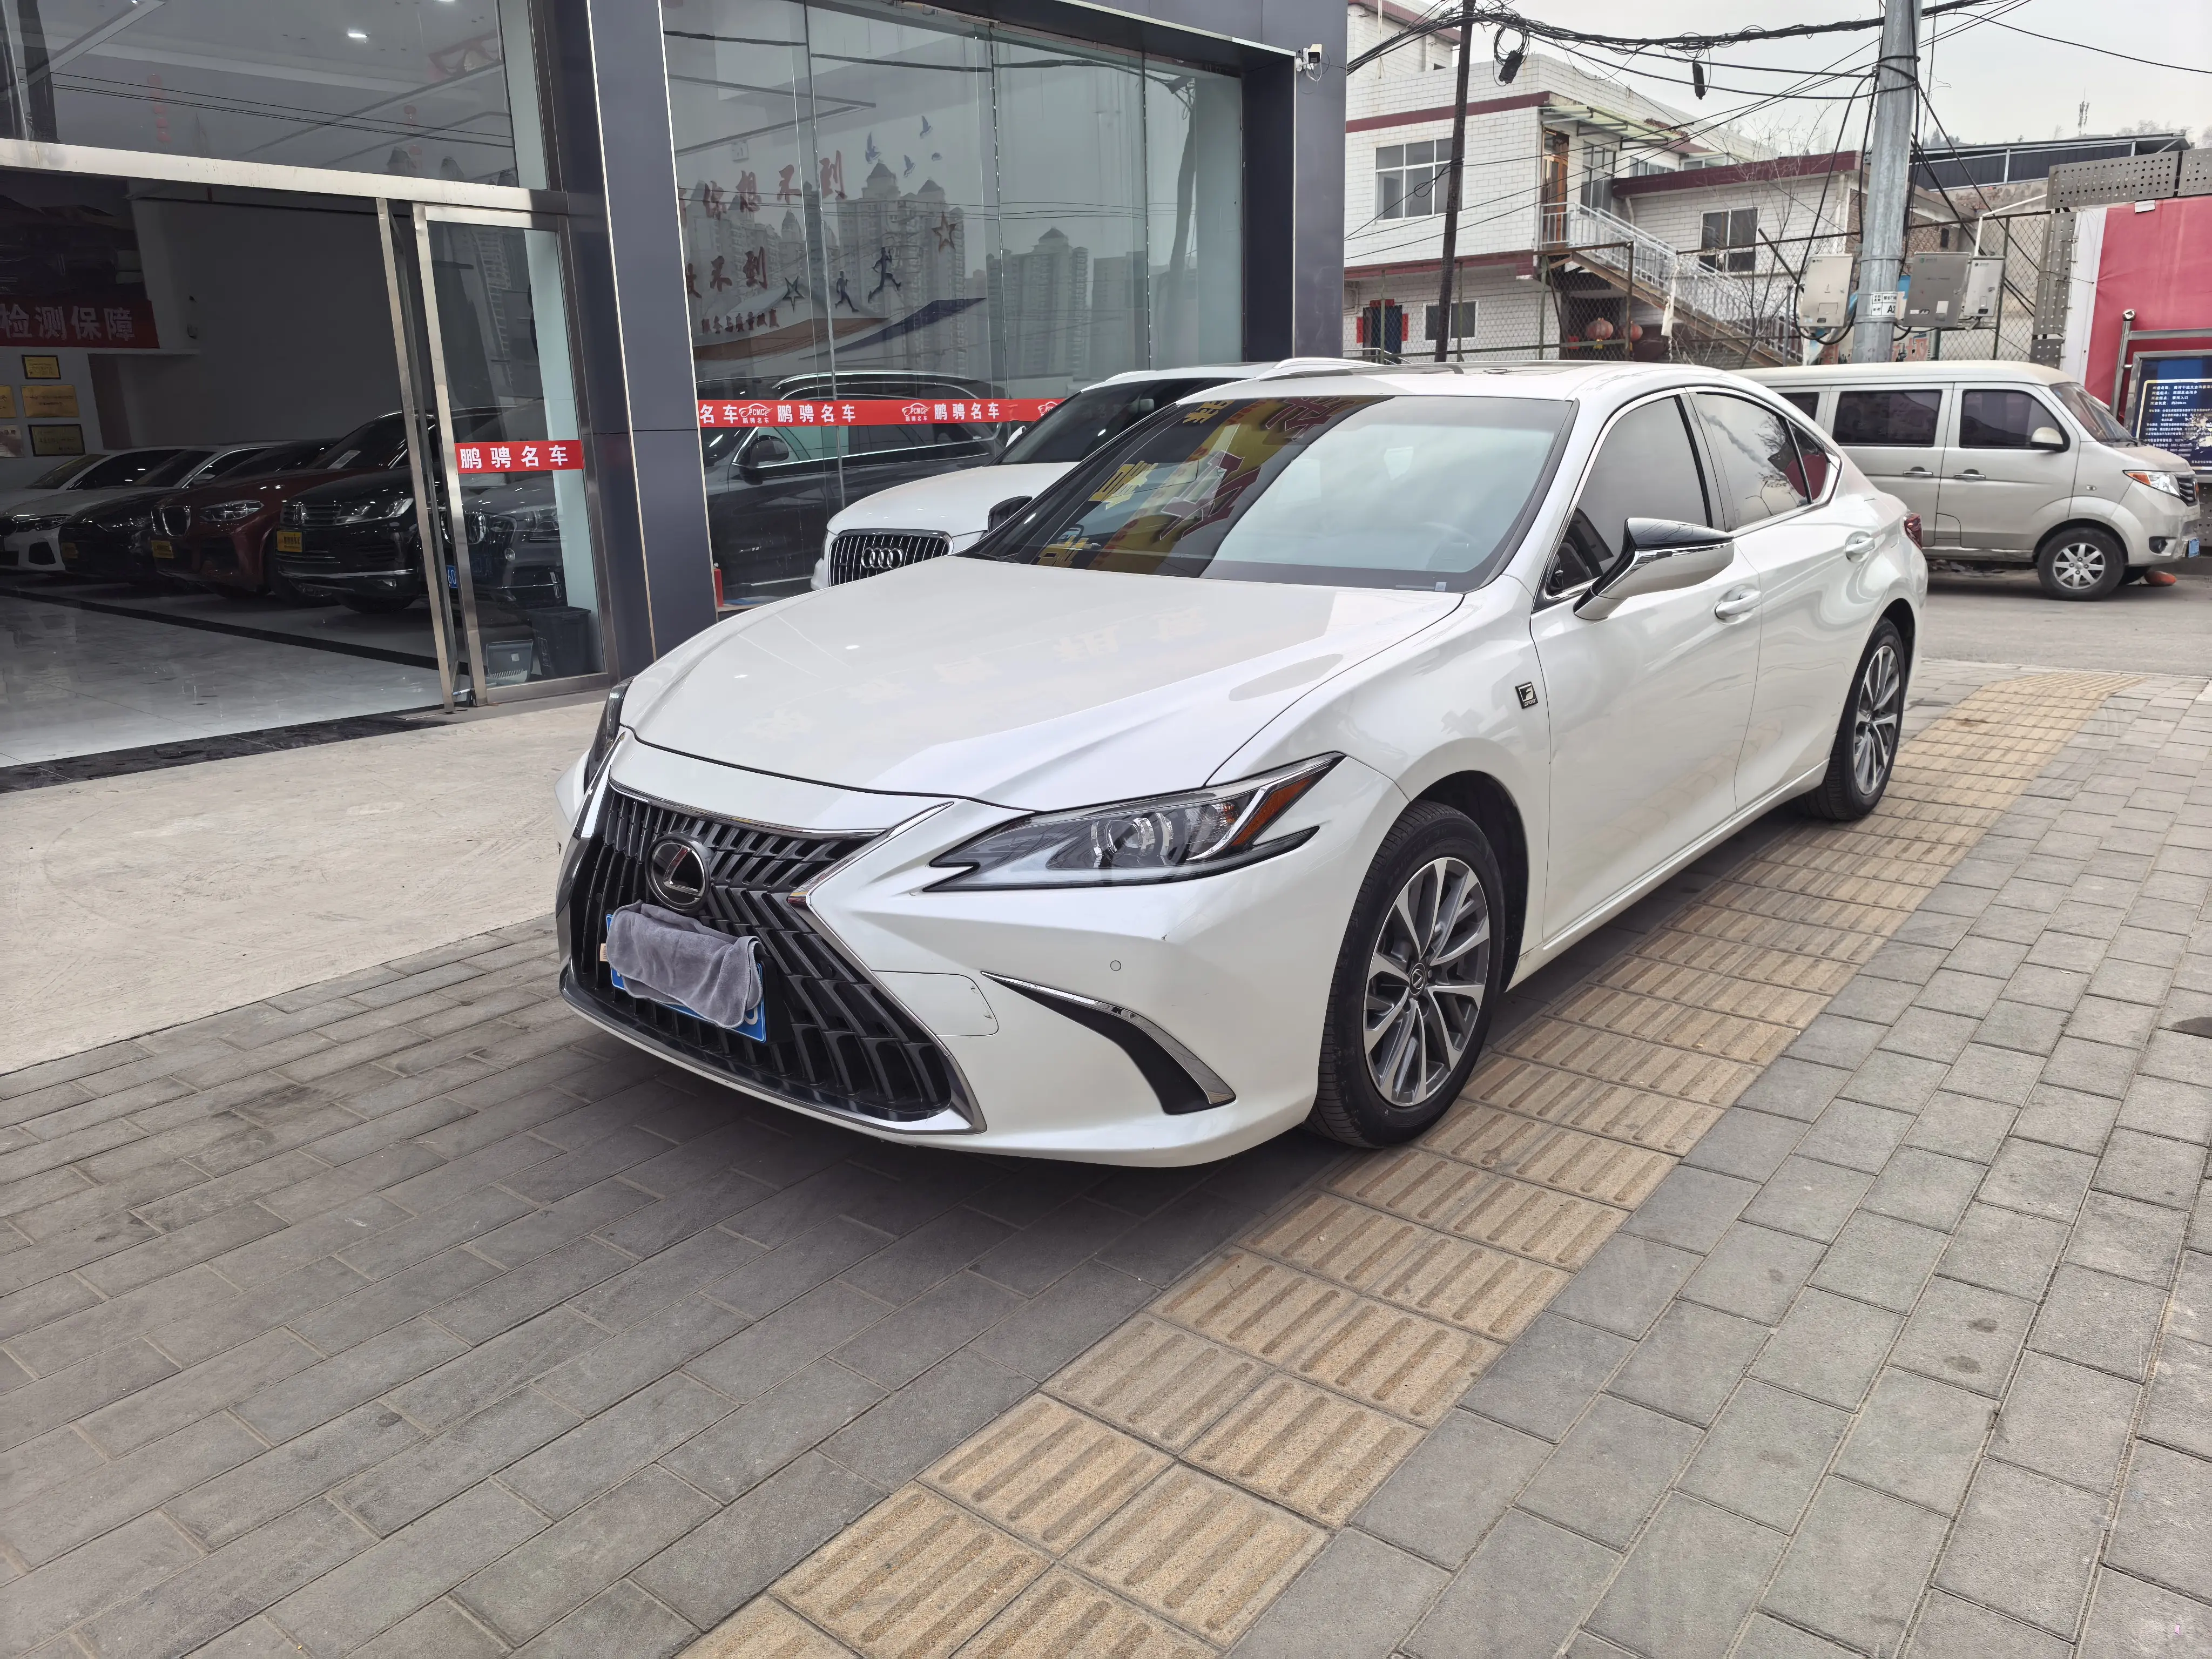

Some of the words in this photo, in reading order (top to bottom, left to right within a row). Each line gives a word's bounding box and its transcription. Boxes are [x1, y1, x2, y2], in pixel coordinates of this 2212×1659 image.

[0, 302, 136, 342] 检测保障
[700, 404, 738, 424] 名车
[777, 404, 855, 423] 鹏骋名车
[934, 402, 1000, 420] 鹏骋名车
[460, 444, 568, 469] 鹏骋名车
